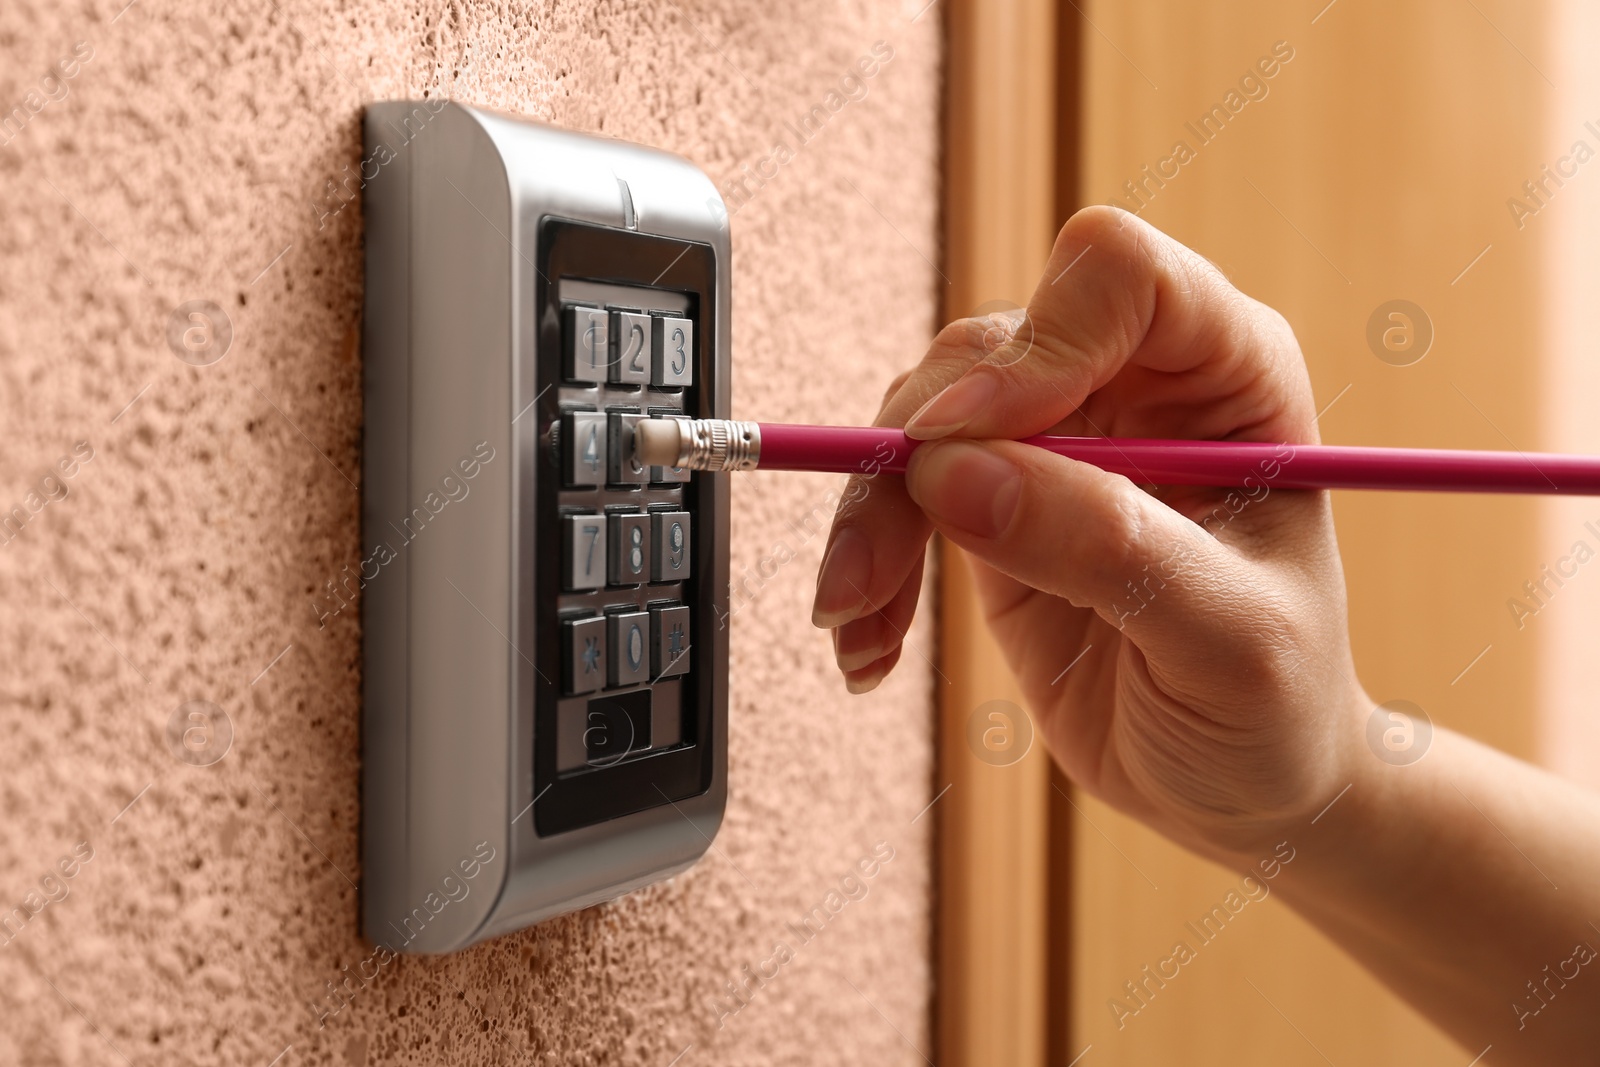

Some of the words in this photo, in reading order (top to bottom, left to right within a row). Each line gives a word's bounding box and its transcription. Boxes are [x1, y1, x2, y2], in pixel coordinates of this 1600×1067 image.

[586, 320, 595, 369] 1
[629, 323, 645, 374] 2
[671, 327, 686, 375] 3
[582, 423, 600, 474] 4
[582, 525, 600, 576] 7
[629, 524, 644, 574] 8
[669, 521, 685, 570] 9
[627, 623, 644, 673] 0
